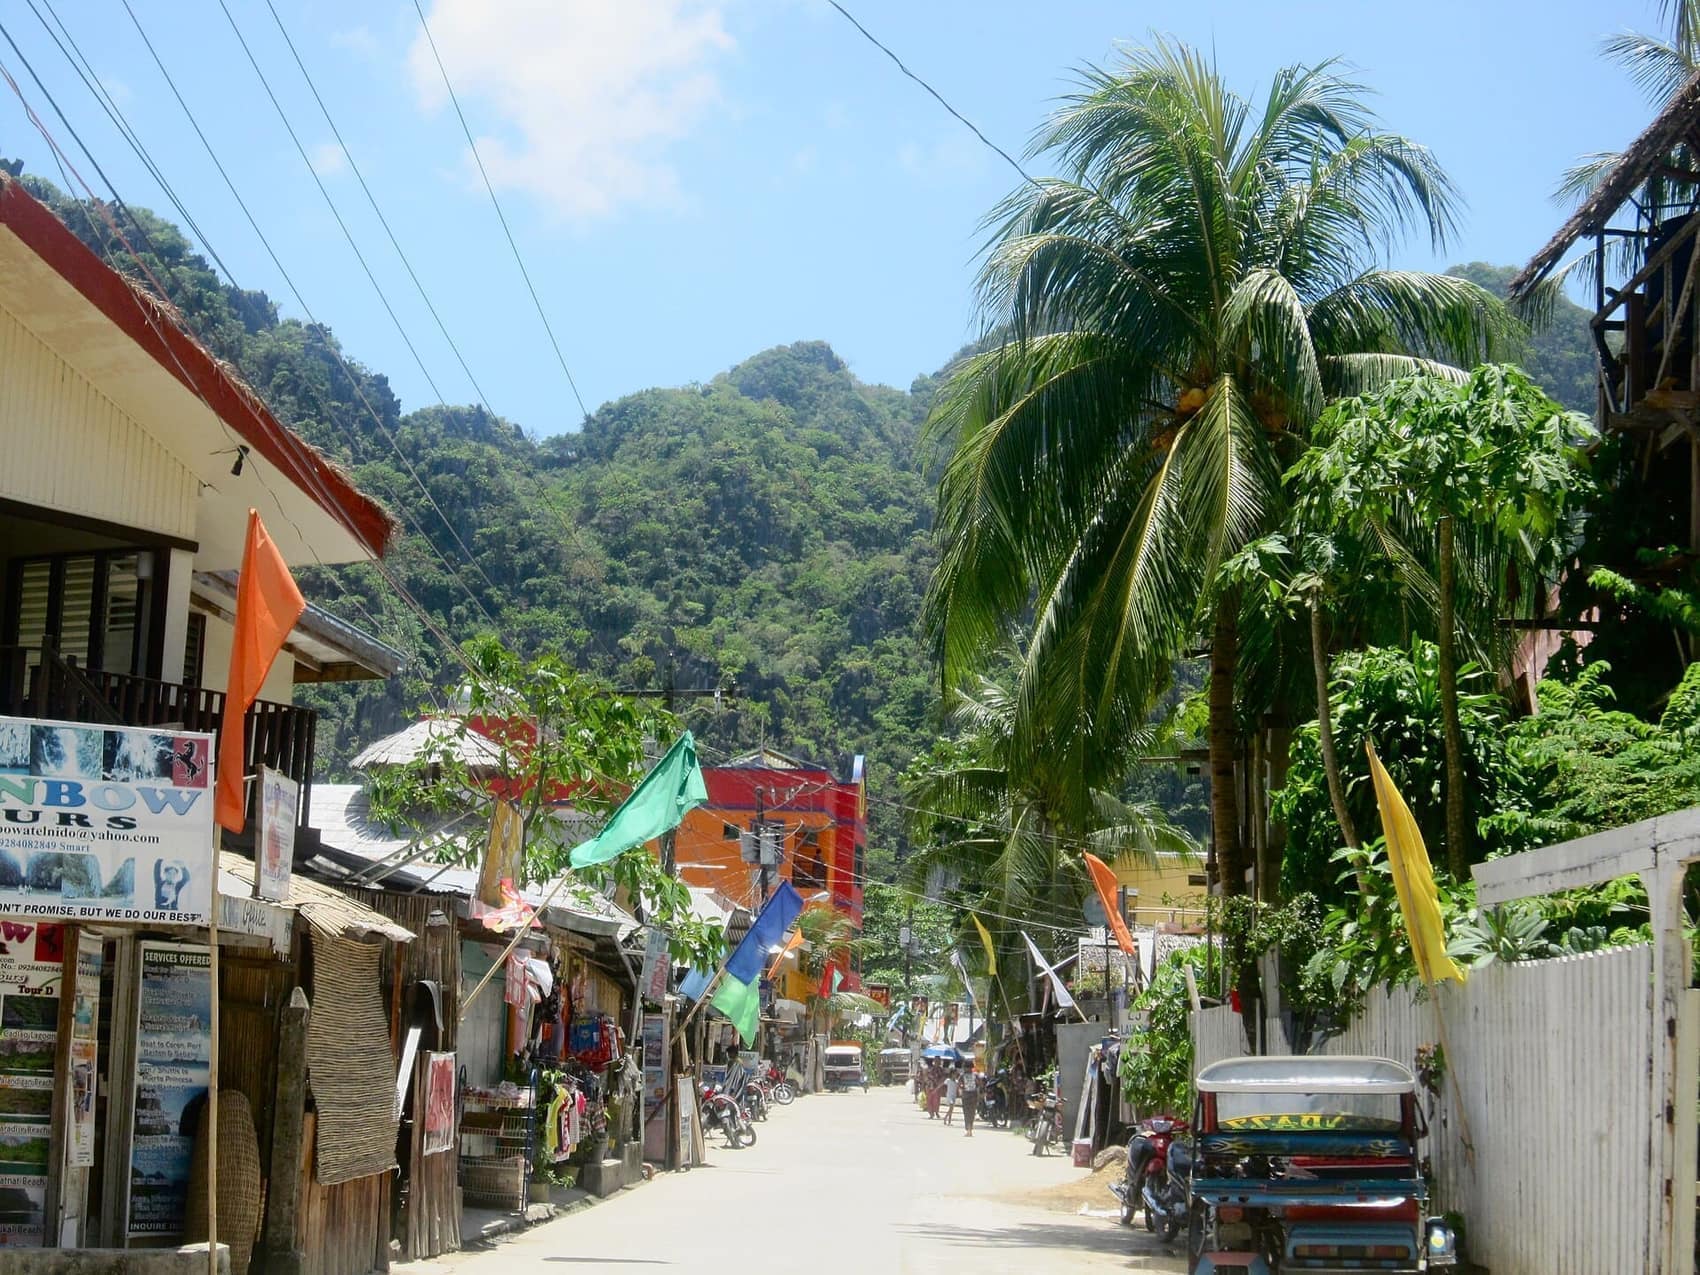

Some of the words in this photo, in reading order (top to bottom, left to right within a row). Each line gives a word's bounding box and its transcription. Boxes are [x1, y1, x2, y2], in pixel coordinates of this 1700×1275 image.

[59, 841, 90, 852] Smart
[0, 903, 22, 913] N'T
[23, 904, 77, 917] PROMISE,
[80, 907, 103, 917] BUT
[105, 908, 122, 918] WE
[125, 909, 140, 919] DO
[143, 910, 167, 921] OUR
[145, 952, 178, 964] SERVICES
[18, 984, 43, 994] Tour
[45, 986, 54, 994] D
